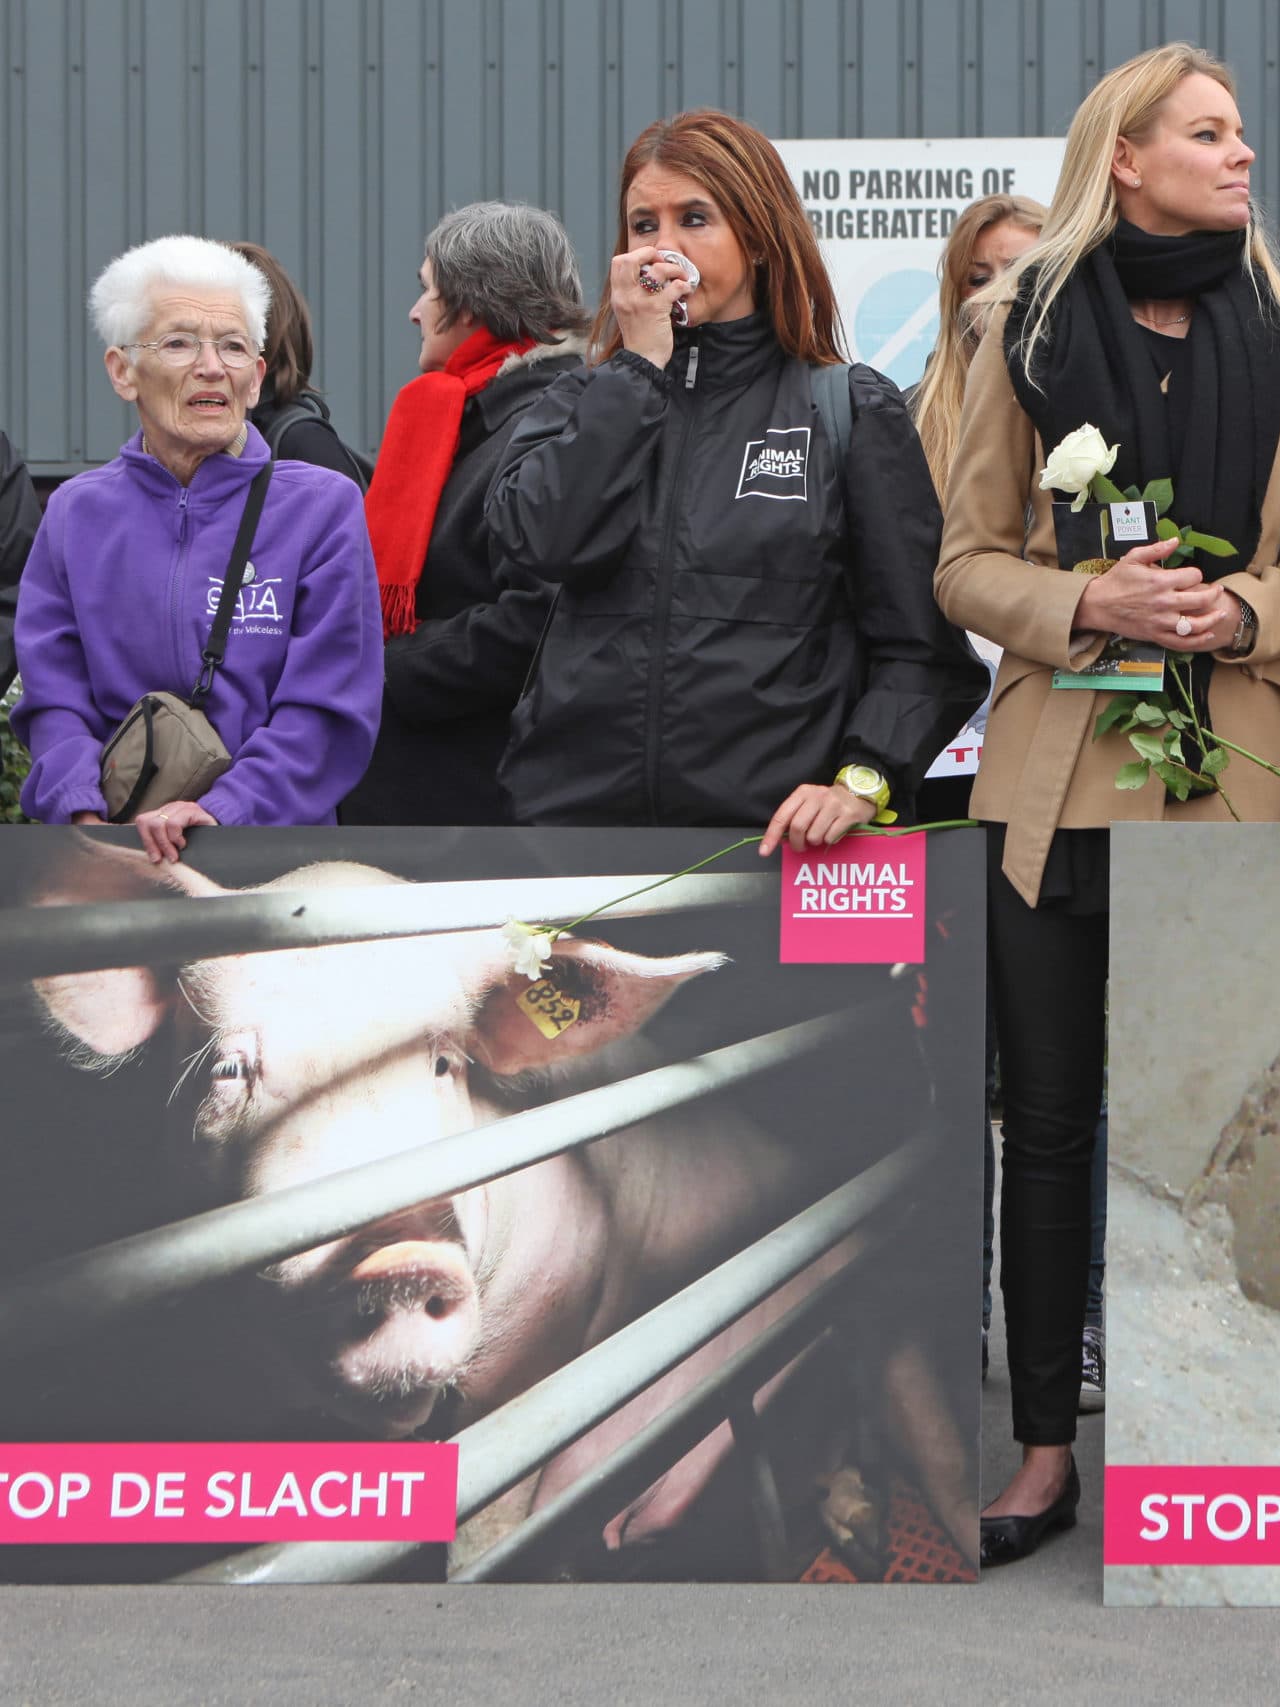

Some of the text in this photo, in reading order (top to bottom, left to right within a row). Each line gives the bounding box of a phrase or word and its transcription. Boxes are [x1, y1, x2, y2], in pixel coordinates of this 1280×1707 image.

[803, 168, 1015, 200] NO PARKING OF
[750, 459, 801, 478] RGHTS
[1116, 516, 1140, 525] PLANT
[793, 863, 914, 886] ANIMAL
[800, 888, 906, 911] RIGHTS
[0, 1471, 425, 1519] OP DE SLACHT
